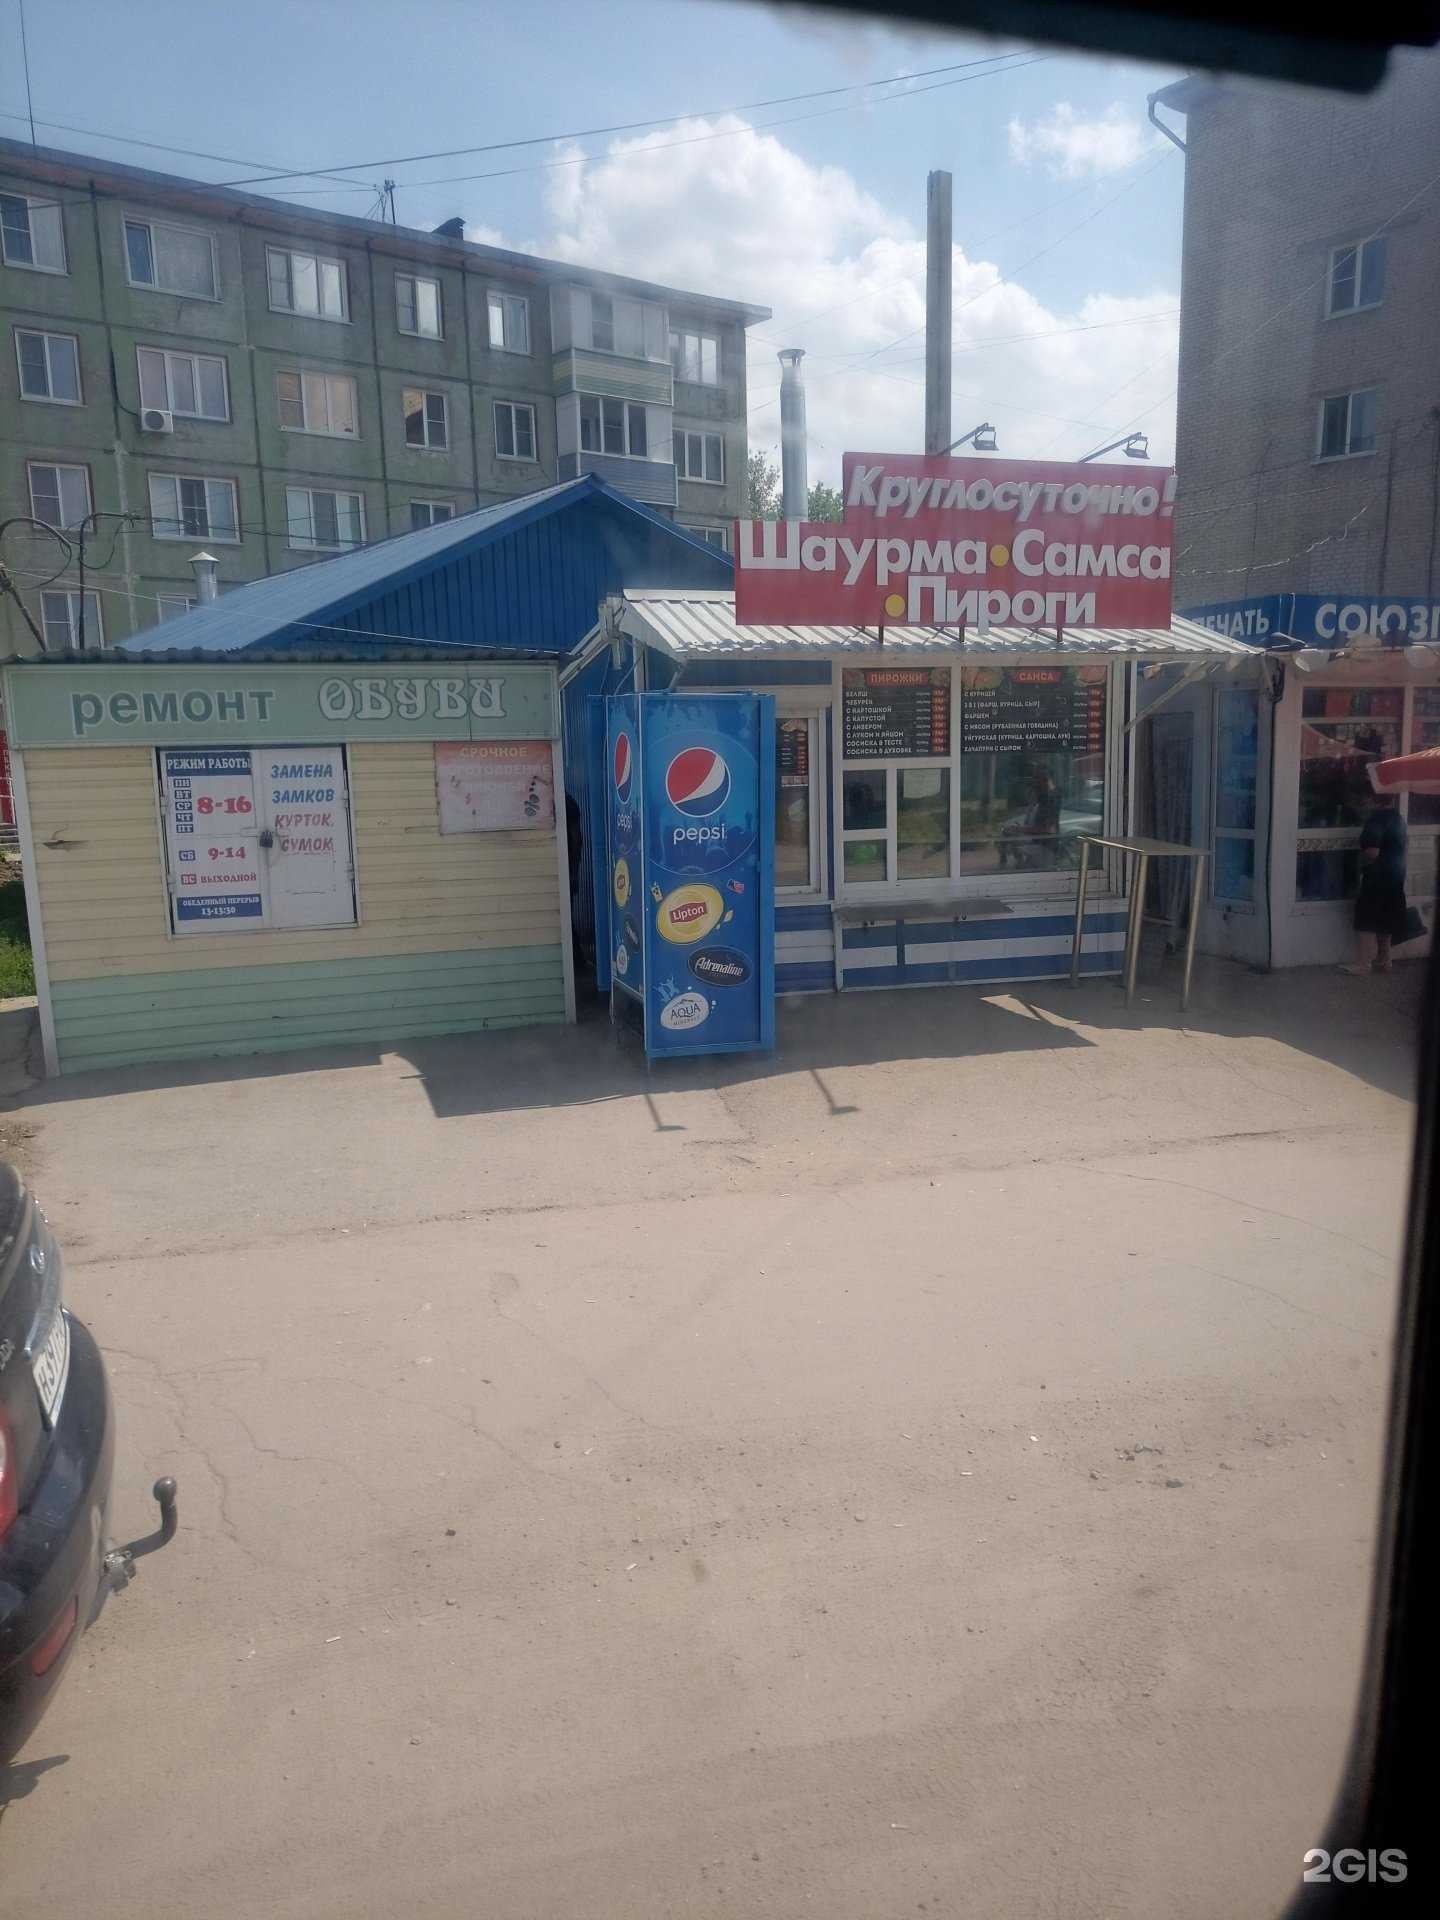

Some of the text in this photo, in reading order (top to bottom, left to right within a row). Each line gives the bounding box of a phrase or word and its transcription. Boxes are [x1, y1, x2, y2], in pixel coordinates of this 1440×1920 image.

[847, 465, 1178, 522] Круглосуточно!
[740, 520, 1171, 586] Шаурма Самса
[908, 576, 1096, 634] Пироги
[871, 672, 923, 683] ПИРОЖКИ
[1019, 672, 1054, 681] САМСА
[71, 677, 508, 737] ремонт ОБУВИ
[852, 705, 892, 714] КАРТОШКОЙ
[852, 714, 886, 722] КАПУСТОЙ
[846, 739, 877, 747] СОСИСКА
[884, 739, 903, 747] ТЕСТЕ
[461, 746, 529, 758] СРОЧНОЕ
[167, 757, 252, 770] РЕЖИМ РАБОТЫ
[271, 764, 333, 779] ЗАМЕНА
[175, 779, 191, 788] ПН
[175, 790, 191, 799] ВТ
[272, 788, 335, 804] ЗАМКОВ
[176, 802, 192, 811] СР
[197, 796, 252, 815] 8-16
[177, 813, 193, 822] ЧТ
[673, 823, 727, 845] pepsi
[281, 837, 333, 852] СУМОК
[208, 846, 247, 860] 9-14
[201, 871, 257, 884] ВЫХОДНОЙ
[672, 904, 705, 921] Lipton
[694, 956, 745, 977] Adrenaline
[671, 1003, 701, 1020] AQUA
